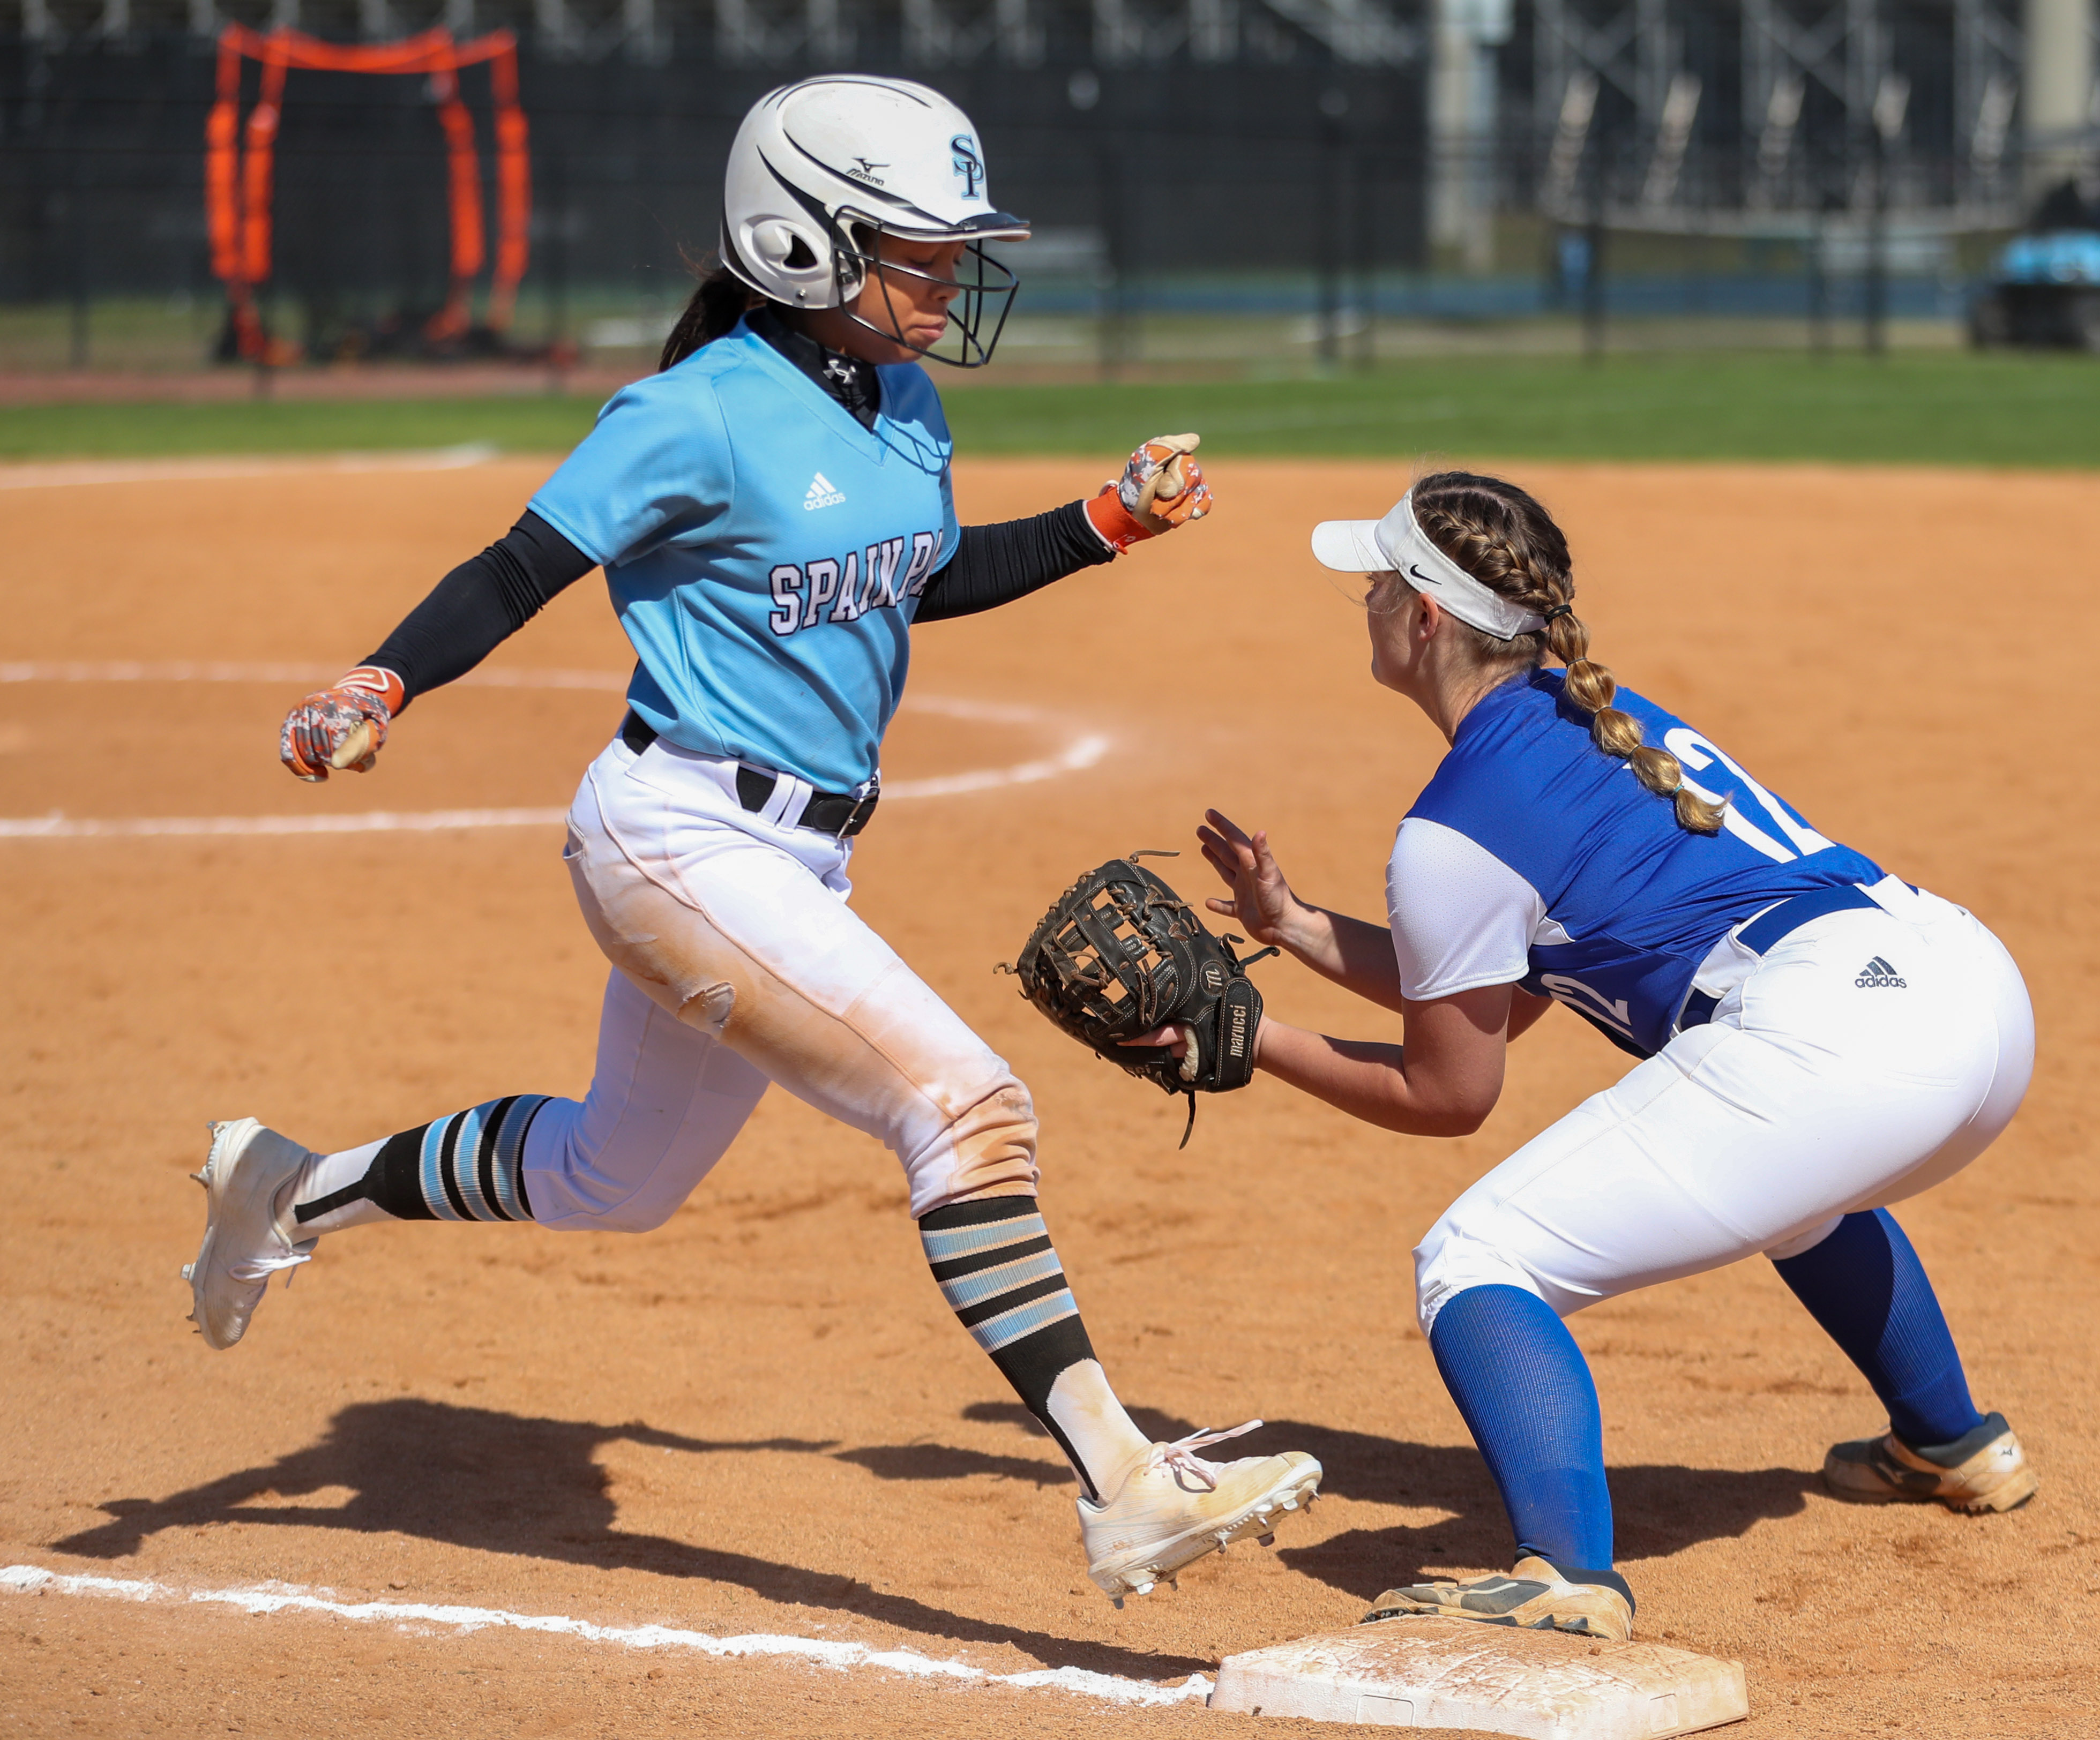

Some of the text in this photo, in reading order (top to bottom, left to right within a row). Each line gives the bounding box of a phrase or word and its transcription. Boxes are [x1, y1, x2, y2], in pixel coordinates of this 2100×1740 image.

[804, 492, 846, 511] adidas
[769, 536, 905, 637] SPAIN
[1855, 974, 1907, 989] adidas
[1230, 1004, 1246, 1058] marucci
